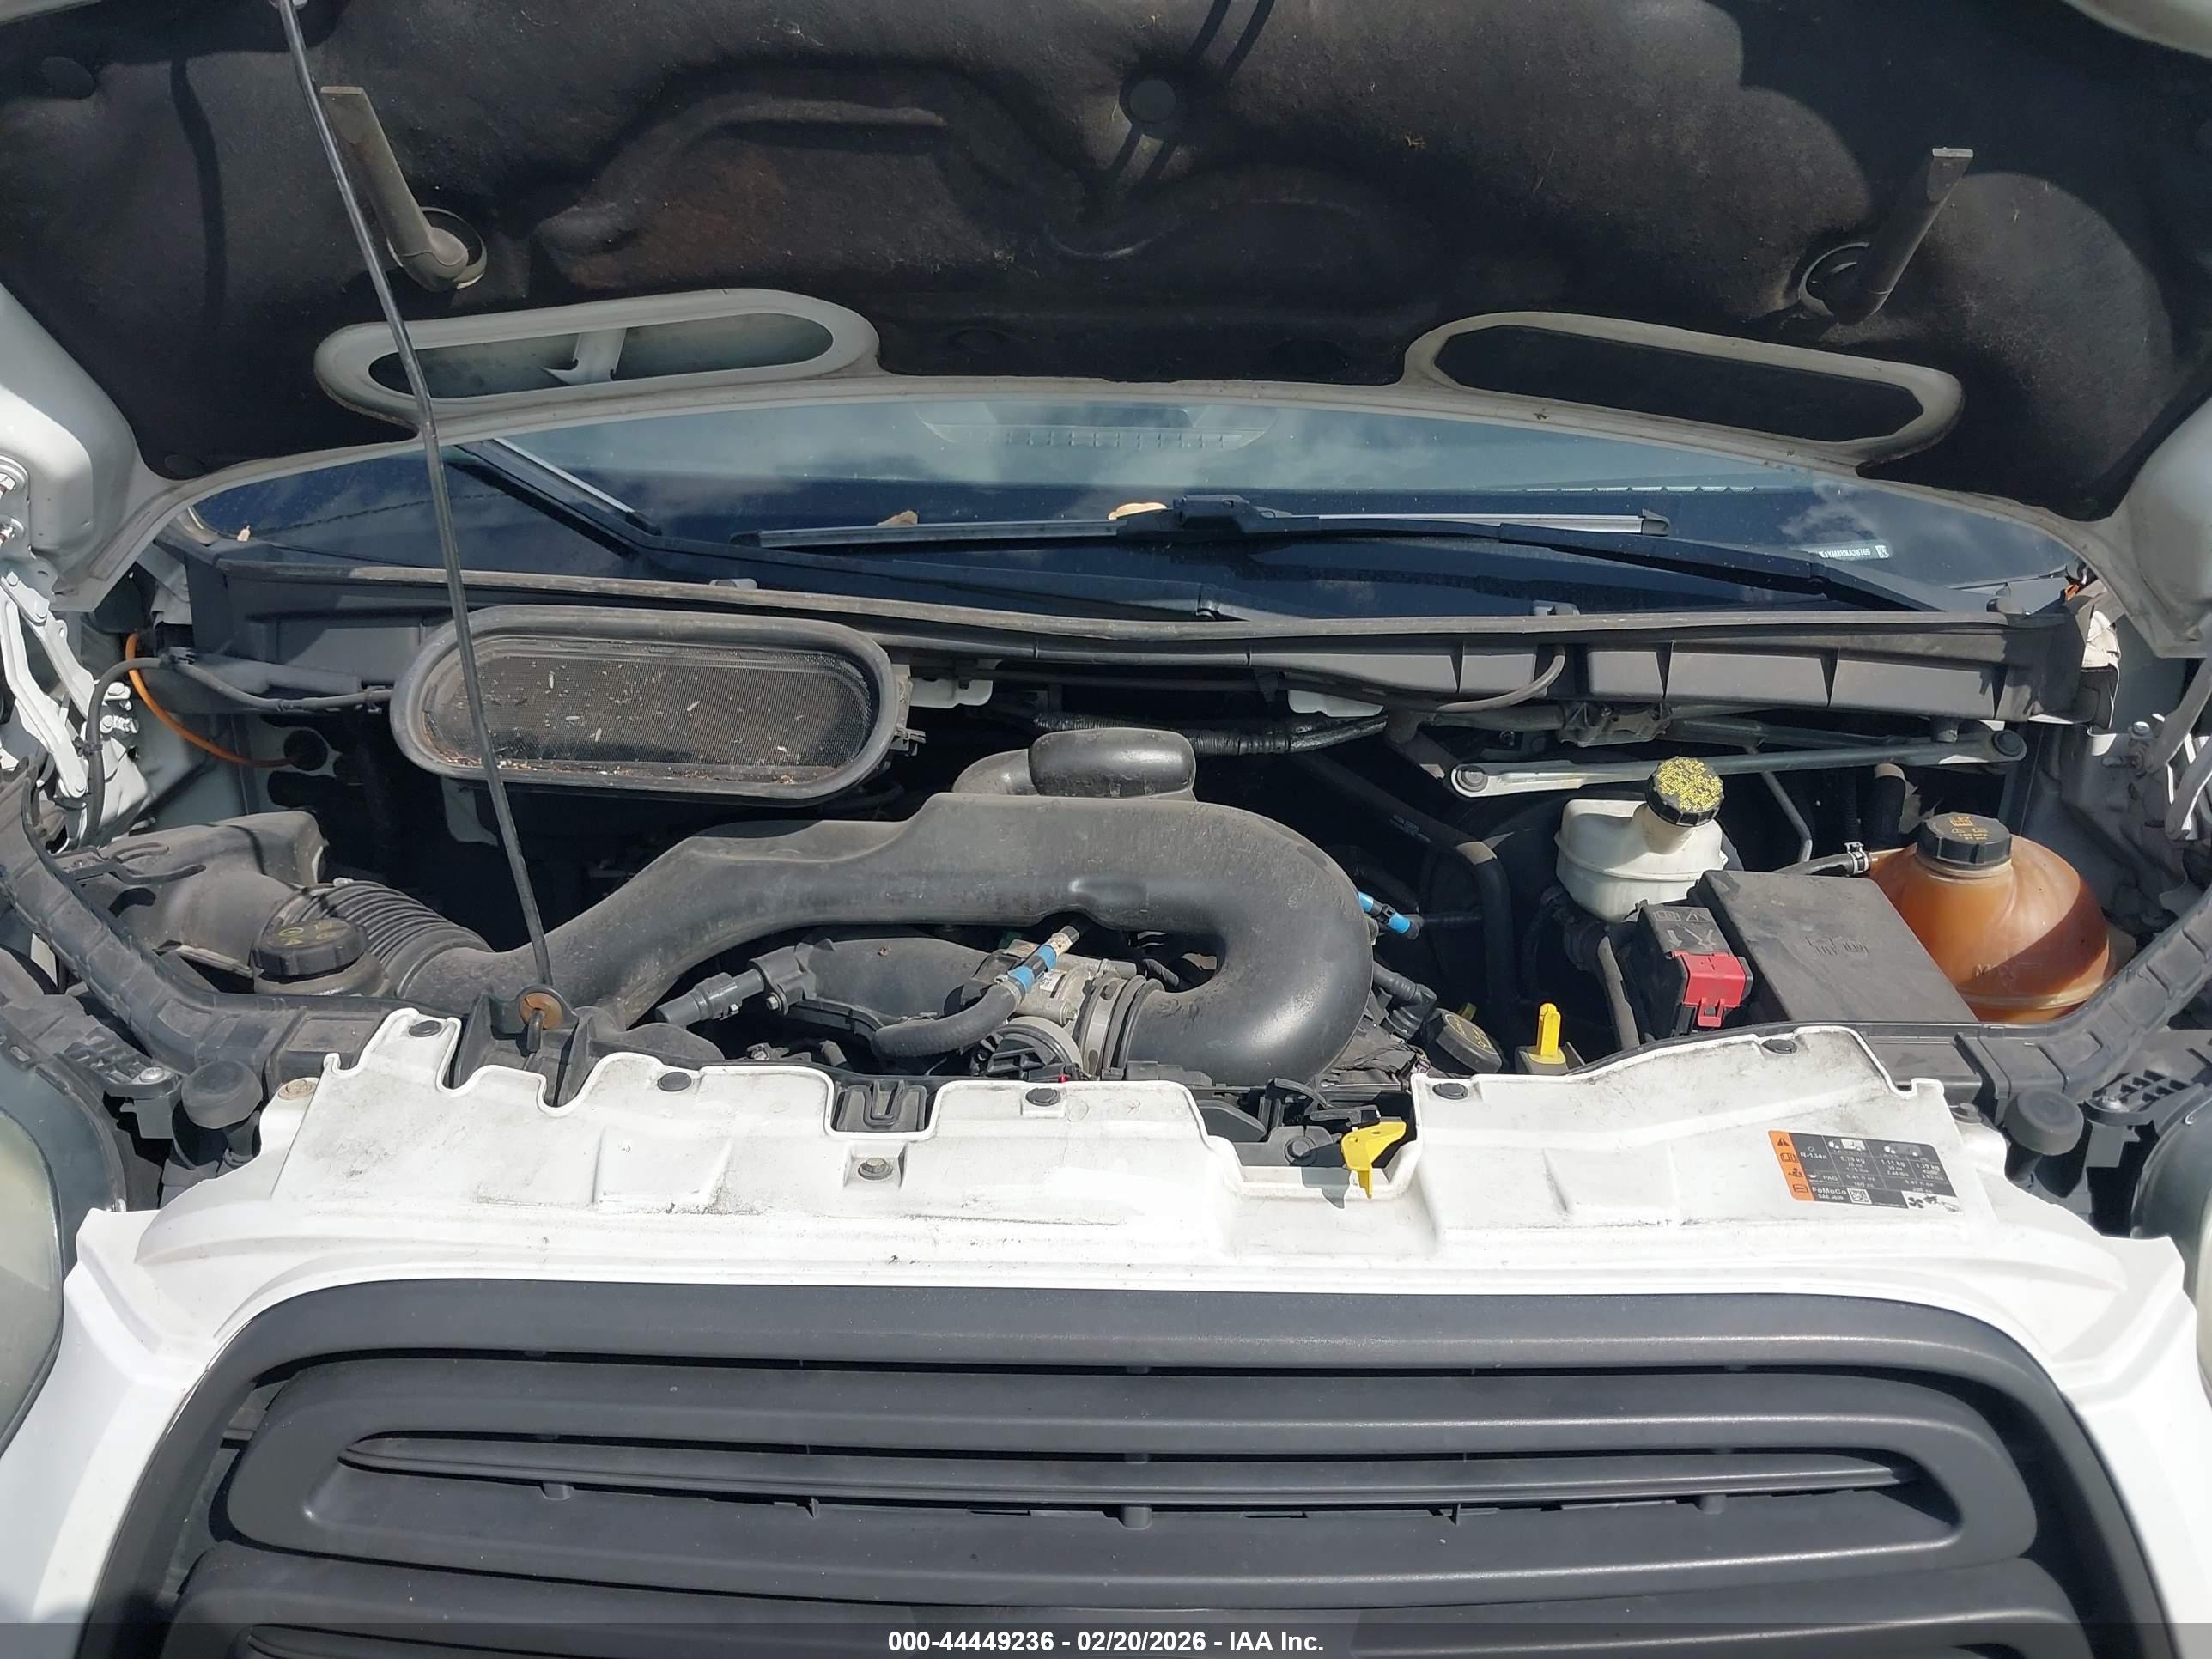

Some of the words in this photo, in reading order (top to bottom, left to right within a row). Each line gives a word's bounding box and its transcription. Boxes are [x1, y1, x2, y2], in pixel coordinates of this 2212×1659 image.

[1816, 548, 1871, 558] E1YM8HKA38769
[1800, 1152, 1828, 1160] R-134a
[1812, 1187, 1847, 1195] FoMoCo
